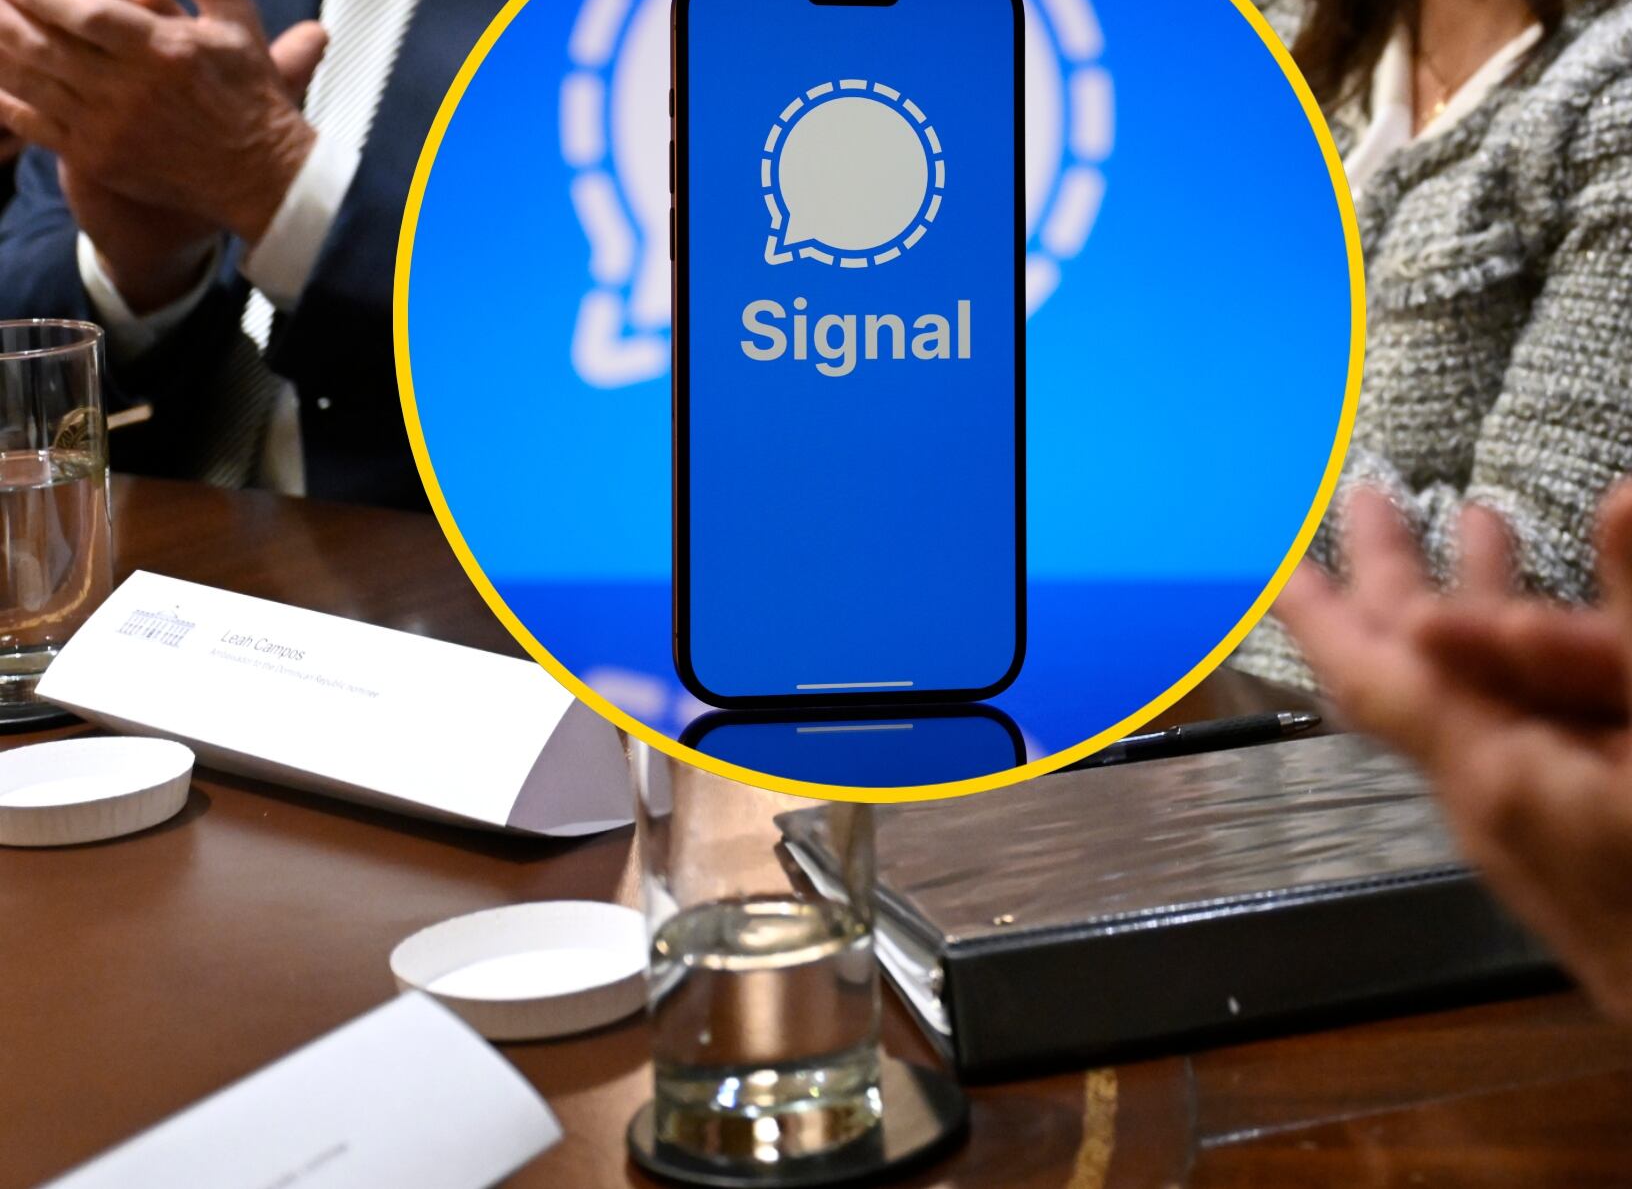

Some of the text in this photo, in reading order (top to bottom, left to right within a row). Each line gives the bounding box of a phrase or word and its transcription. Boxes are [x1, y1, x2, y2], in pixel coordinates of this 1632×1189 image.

[740, 296, 971, 377] Signal
[220, 629, 307, 661] Leah Campos
